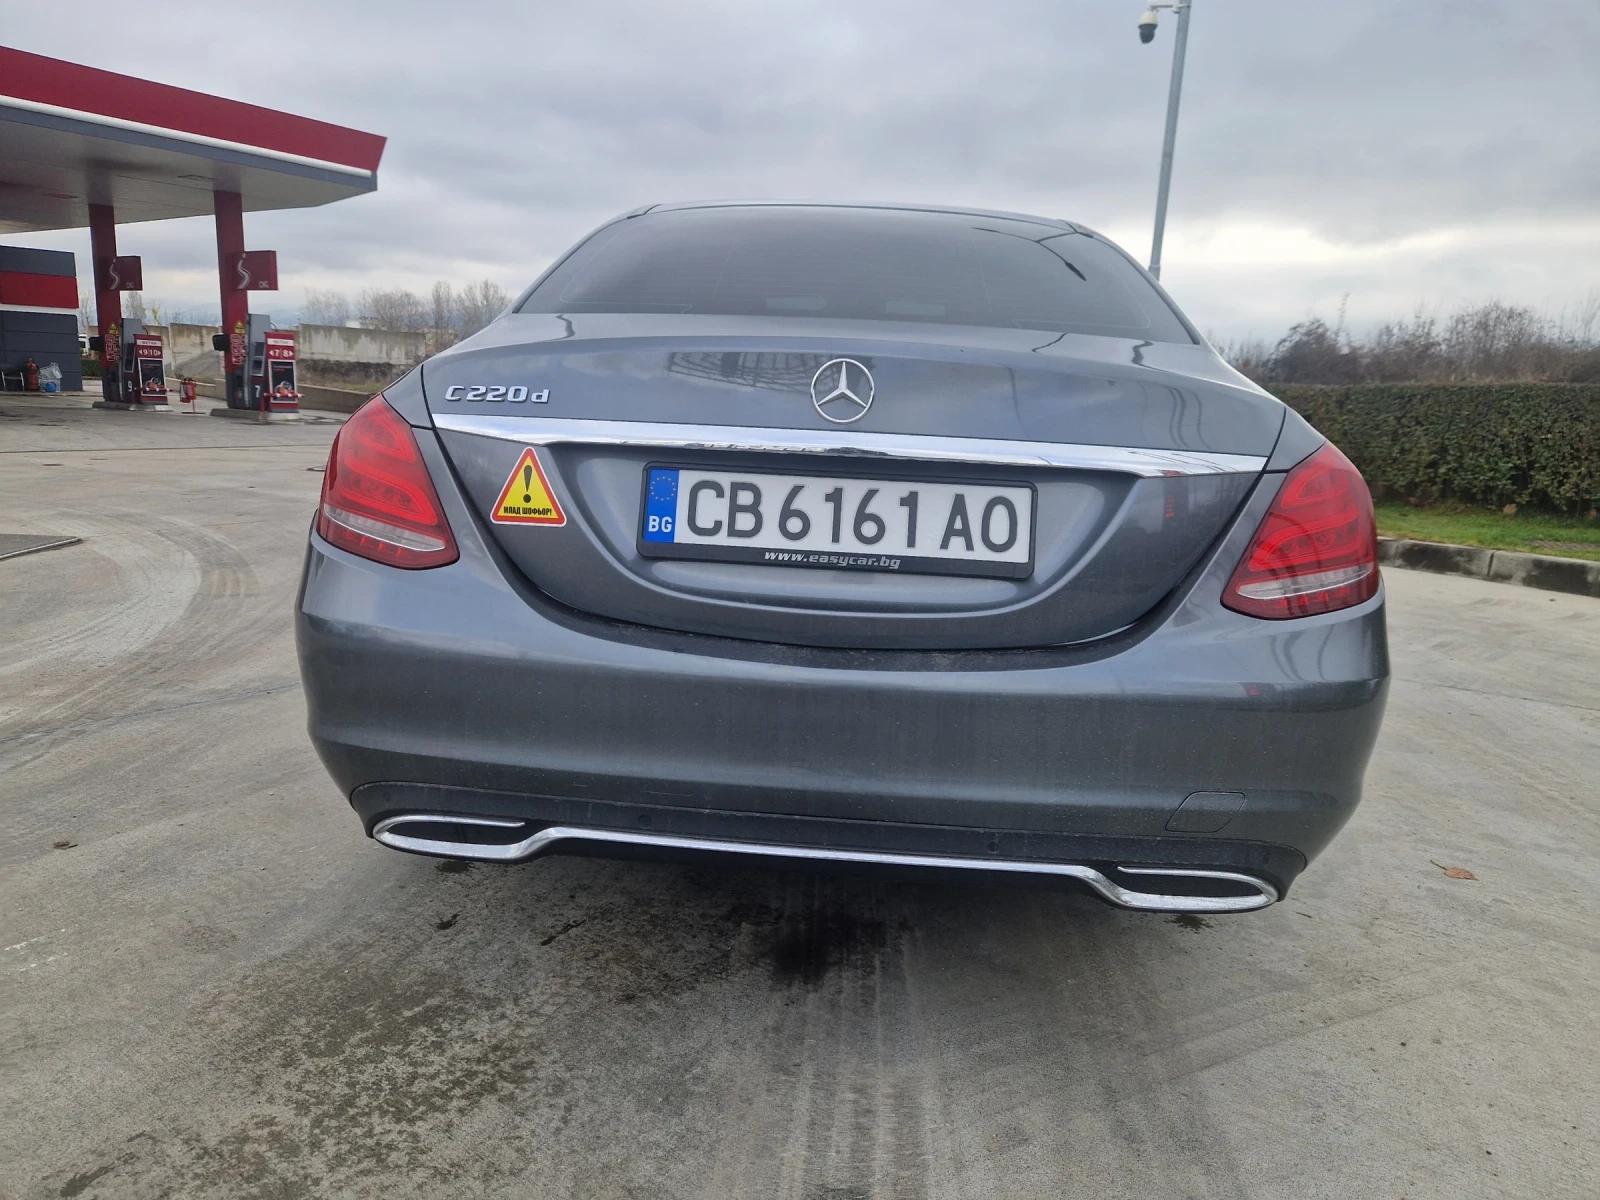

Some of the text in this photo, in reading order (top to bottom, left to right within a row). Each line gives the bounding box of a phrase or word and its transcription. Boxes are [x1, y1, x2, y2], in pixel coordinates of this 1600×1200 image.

[274, 349, 289, 357] 7 8
[127, 380, 133, 392] 9
[254, 384, 260, 398] 7
[648, 515, 673, 533] BG
[687, 479, 1018, 553] CB 6161 AO
[764, 550, 901, 571] www.easycar.bg
